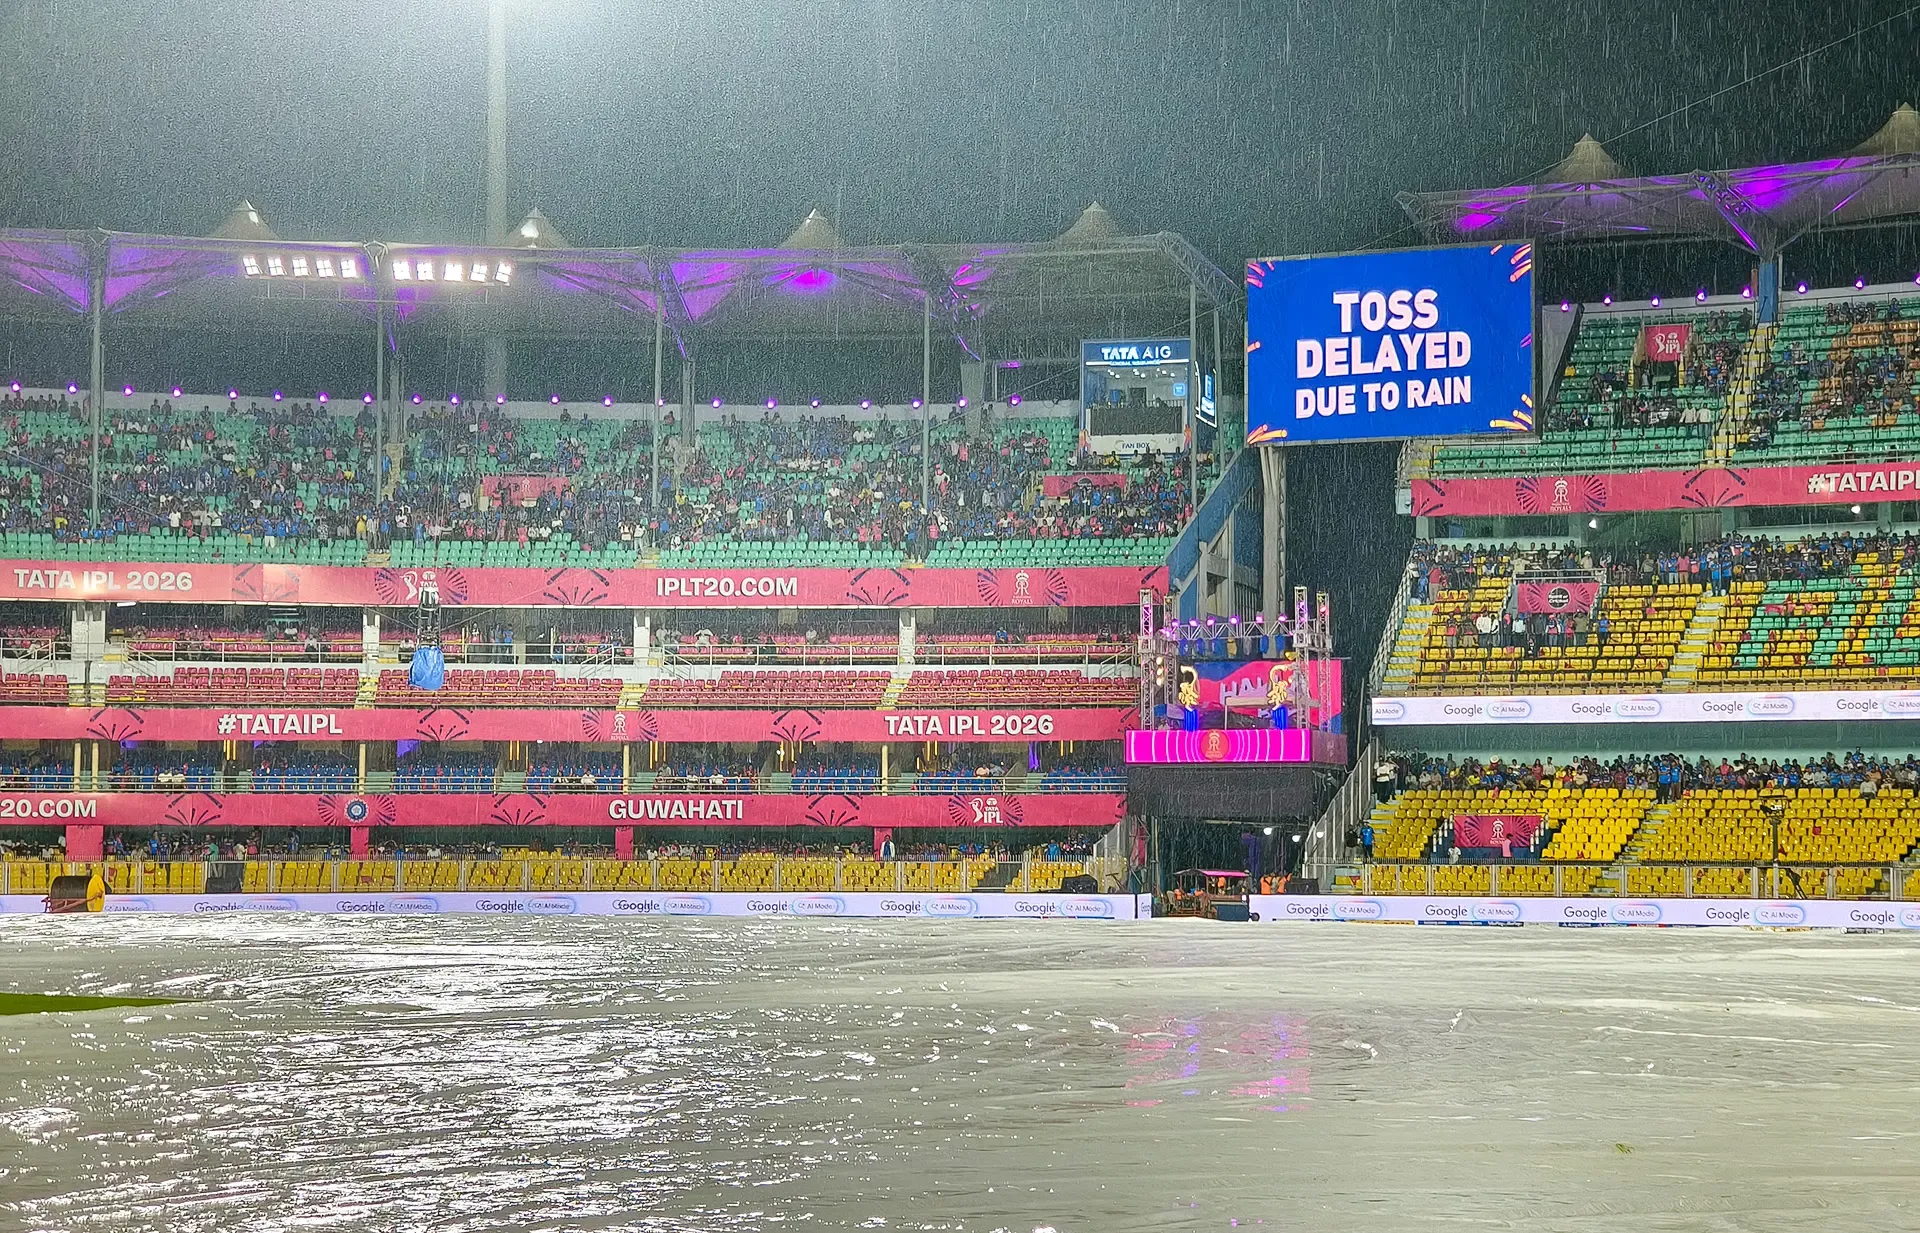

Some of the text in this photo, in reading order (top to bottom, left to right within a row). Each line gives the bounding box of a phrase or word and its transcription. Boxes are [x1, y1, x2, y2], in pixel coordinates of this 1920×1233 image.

[1333, 289, 1439, 333] TOSS
[1101, 346, 1171, 360] TATA AIG
[1296, 331, 1471, 378] DELAYED
[1295, 375, 1471, 419] DUE TO RAIN
[14, 568, 193, 591] TATA IPL 2026
[657, 577, 798, 596] IPLT20.COM
[1444, 704, 1483, 716] Google
[1572, 703, 1611, 716] Google
[1702, 701, 1743, 714] Google
[1836, 699, 1878, 712] Google
[218, 713, 343, 734] #TATAIPL
[884, 714, 1054, 735] TATA IPL 2026
[609, 799, 743, 819] GUWAHATI
[983, 811, 1004, 824] IPL
[747, 900, 788, 913] Google
[880, 900, 921, 914] Google
[1014, 900, 1055, 914] Google
[1286, 902, 1329, 917] Google
[1356, 906, 1375, 914] Mode
[1425, 904, 1468, 919] Google
[1564, 906, 1607, 920] Google
[1635, 909, 1655, 917] Mode
[1705, 907, 1750, 921] Google
[1778, 911, 1798, 919] Mode
[1850, 909, 1895, 924] Google
